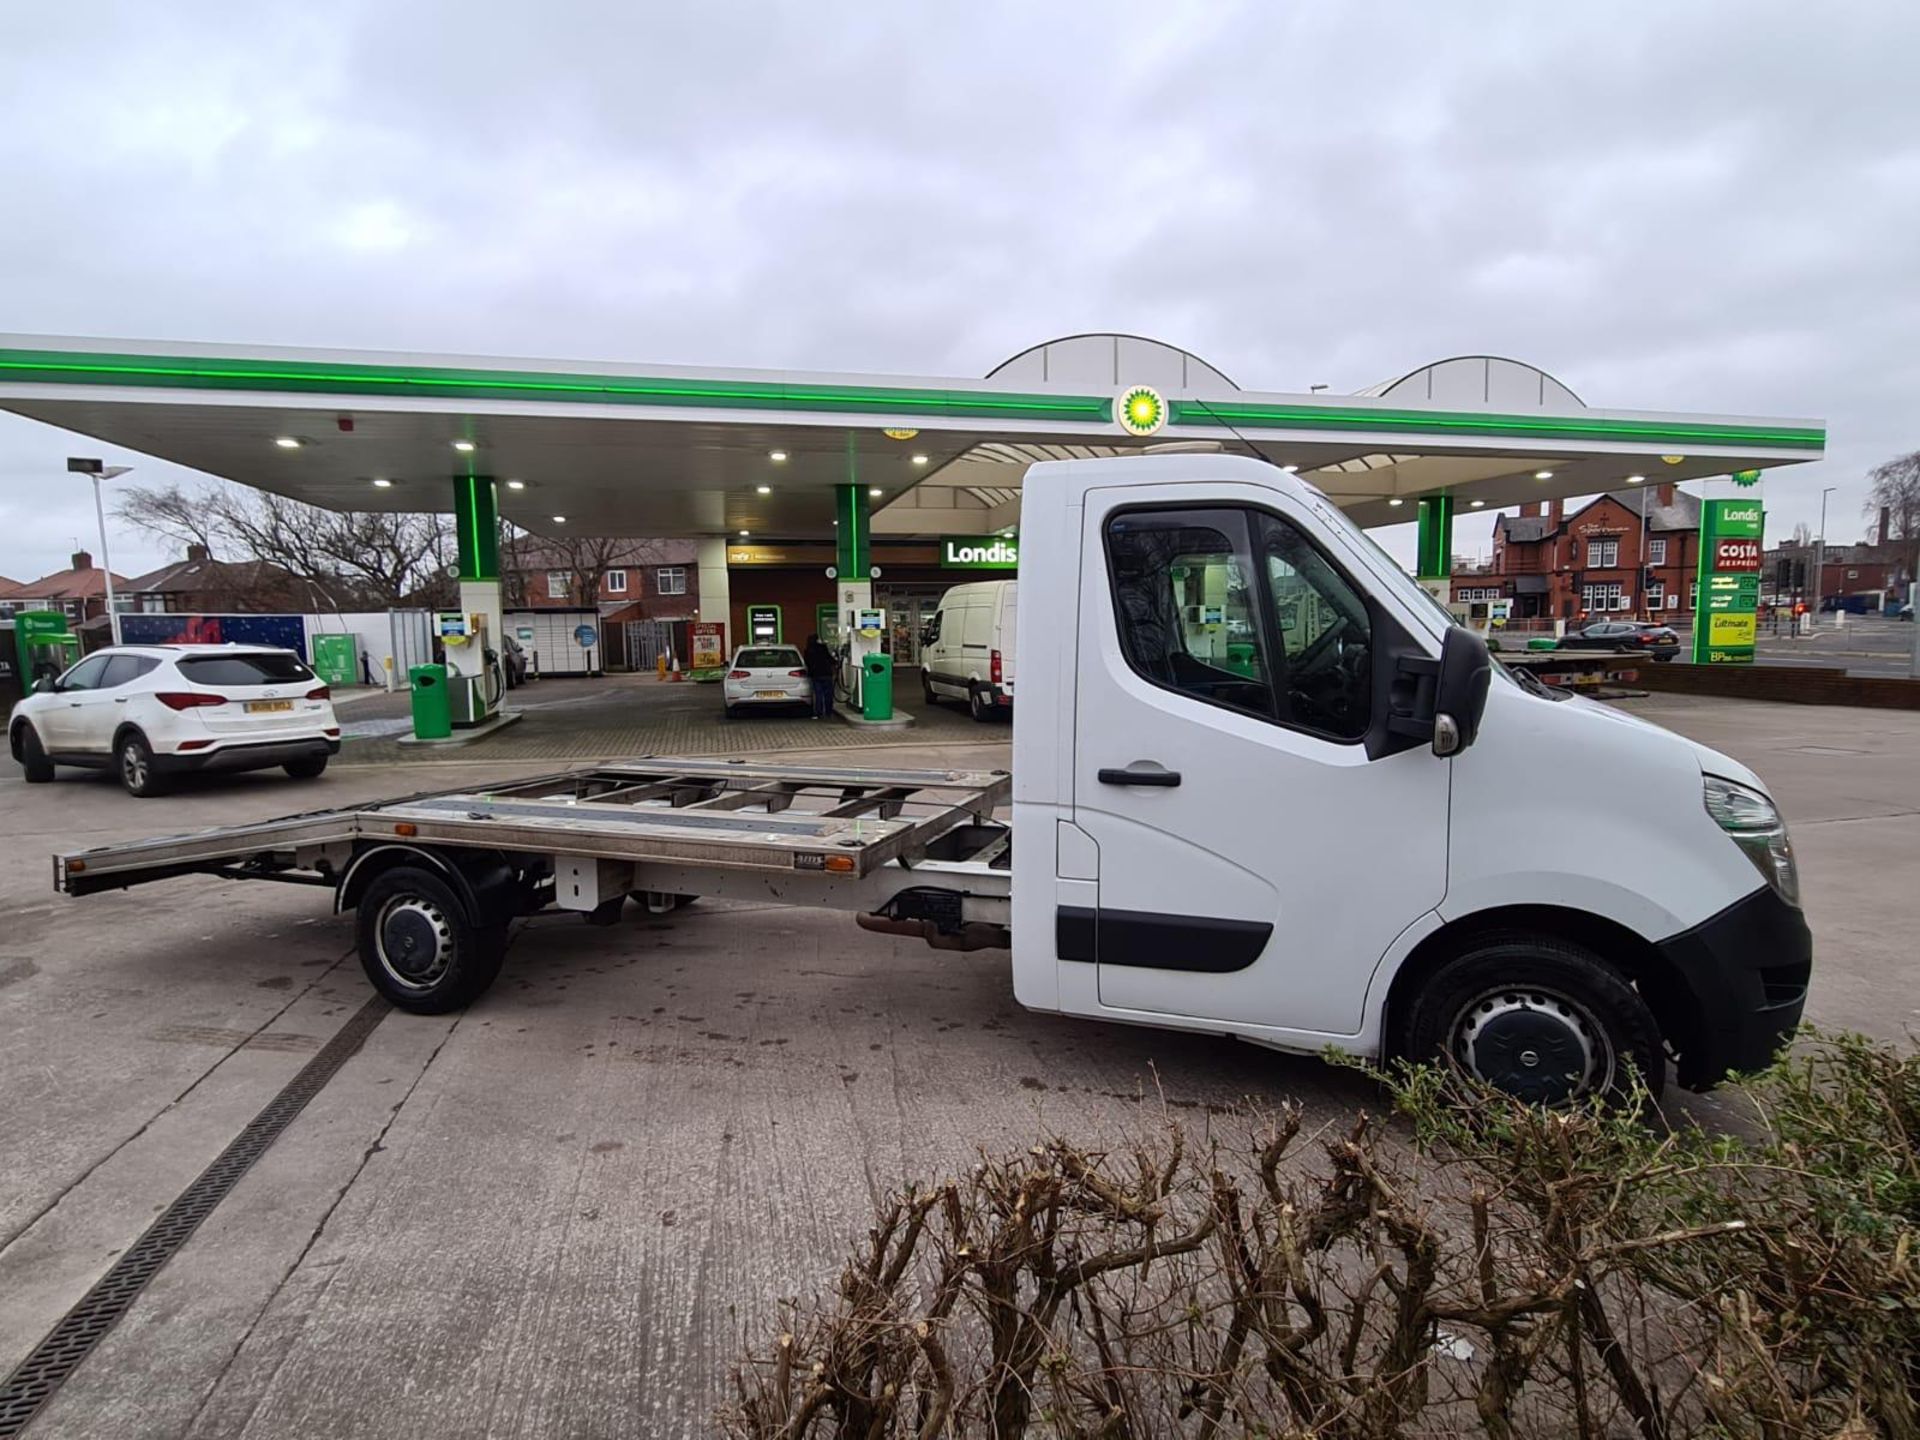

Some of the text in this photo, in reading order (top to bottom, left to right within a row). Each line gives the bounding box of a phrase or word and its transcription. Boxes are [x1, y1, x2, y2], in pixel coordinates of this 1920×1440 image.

[1723, 508, 1758, 521] Londis
[947, 541, 1018, 563] Londis
[1719, 544, 1758, 559] COSTA
